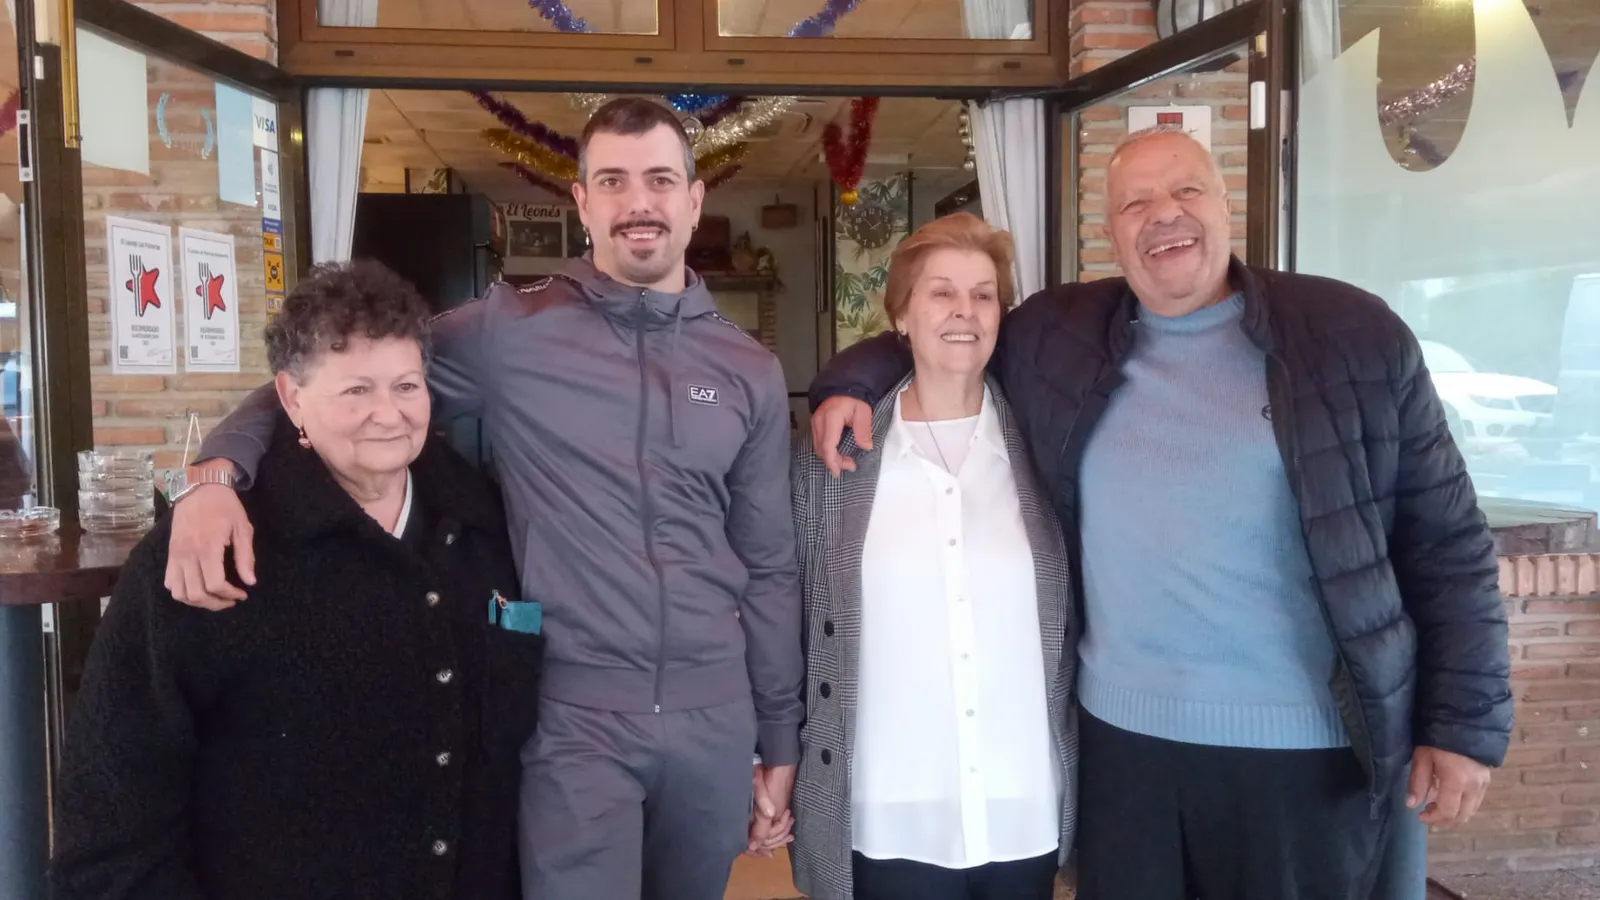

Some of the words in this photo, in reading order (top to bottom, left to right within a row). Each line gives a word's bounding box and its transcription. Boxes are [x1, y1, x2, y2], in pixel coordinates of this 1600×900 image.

[254, 113, 276, 134] VISA
[506, 203, 518, 217] El
[520, 203, 560, 221] Leonés
[690, 387, 716, 400] EA7
